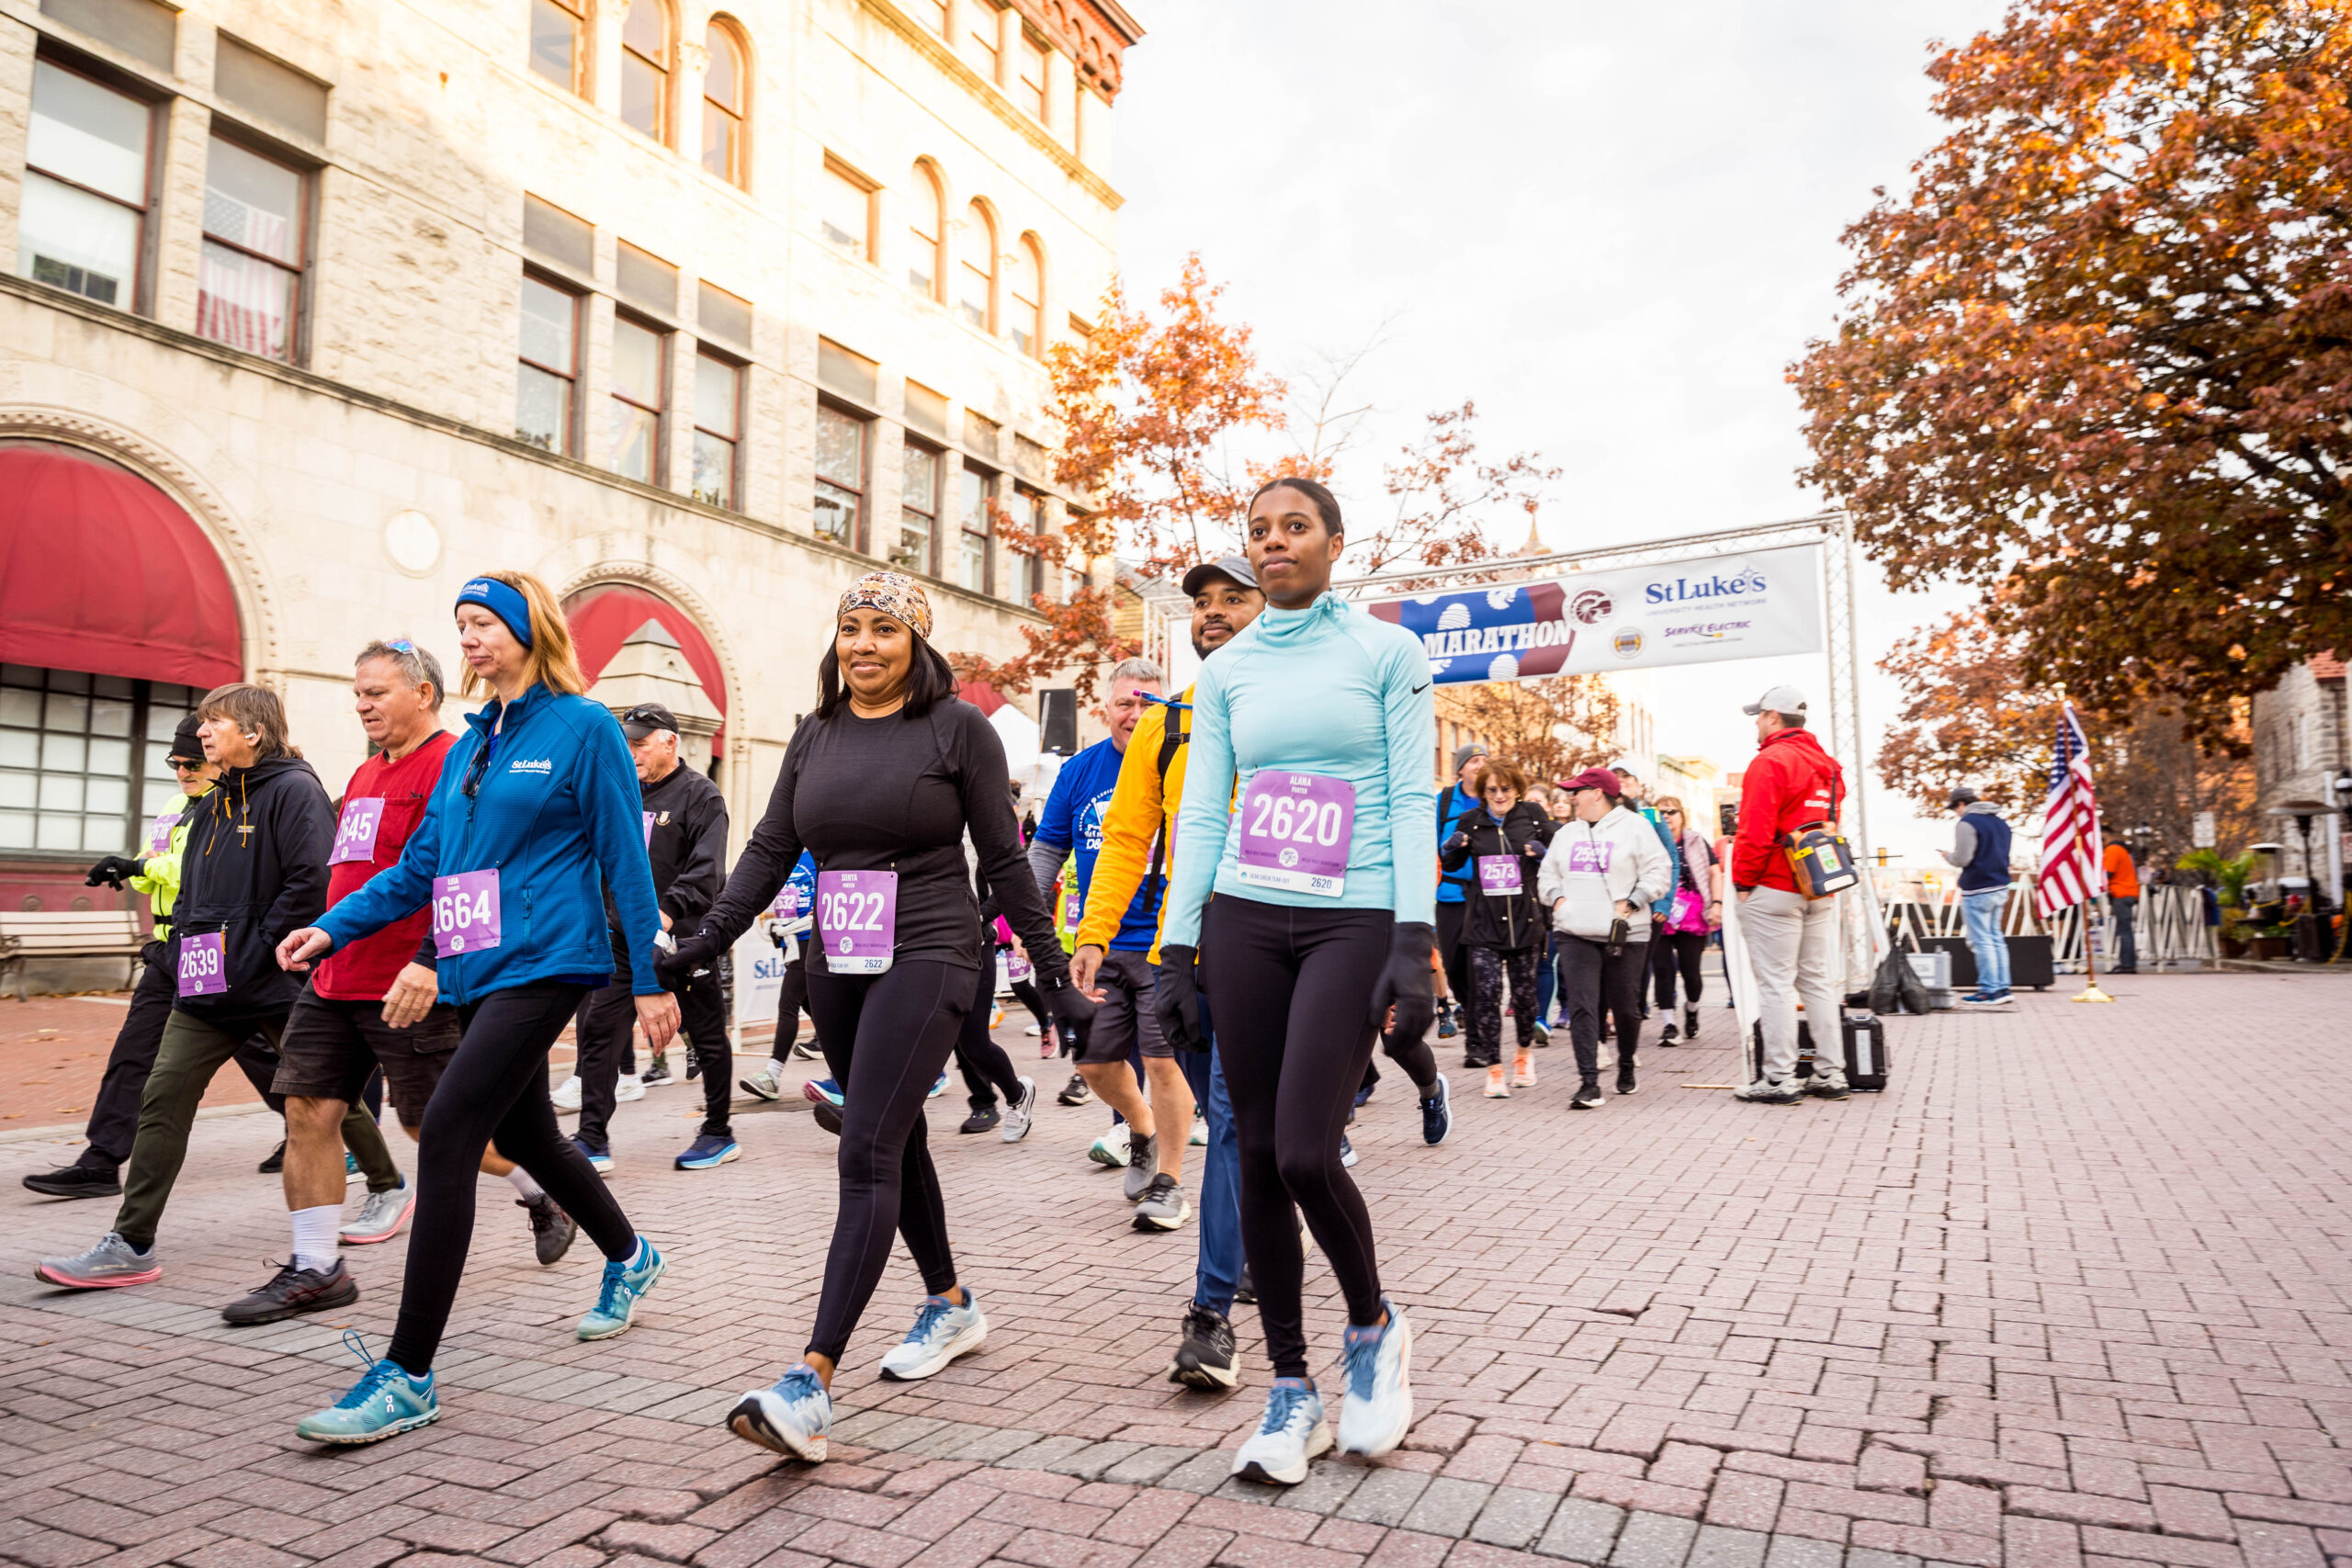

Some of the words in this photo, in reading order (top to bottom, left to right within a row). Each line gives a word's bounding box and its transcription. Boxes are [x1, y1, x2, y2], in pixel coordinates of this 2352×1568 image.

[1423, 619, 1570, 659] MARATHON
[1290, 775, 1311, 787] ALANA
[337, 813, 373, 847] 2645
[1250, 794, 1342, 846] 2620
[1086, 838, 1102, 850] D&
[1484, 863, 1515, 879] 2573
[1312, 877, 1332, 889] 2620
[822, 892, 885, 931] 2622
[181, 948, 218, 978] 2639
[865, 960, 883, 968] 2622
